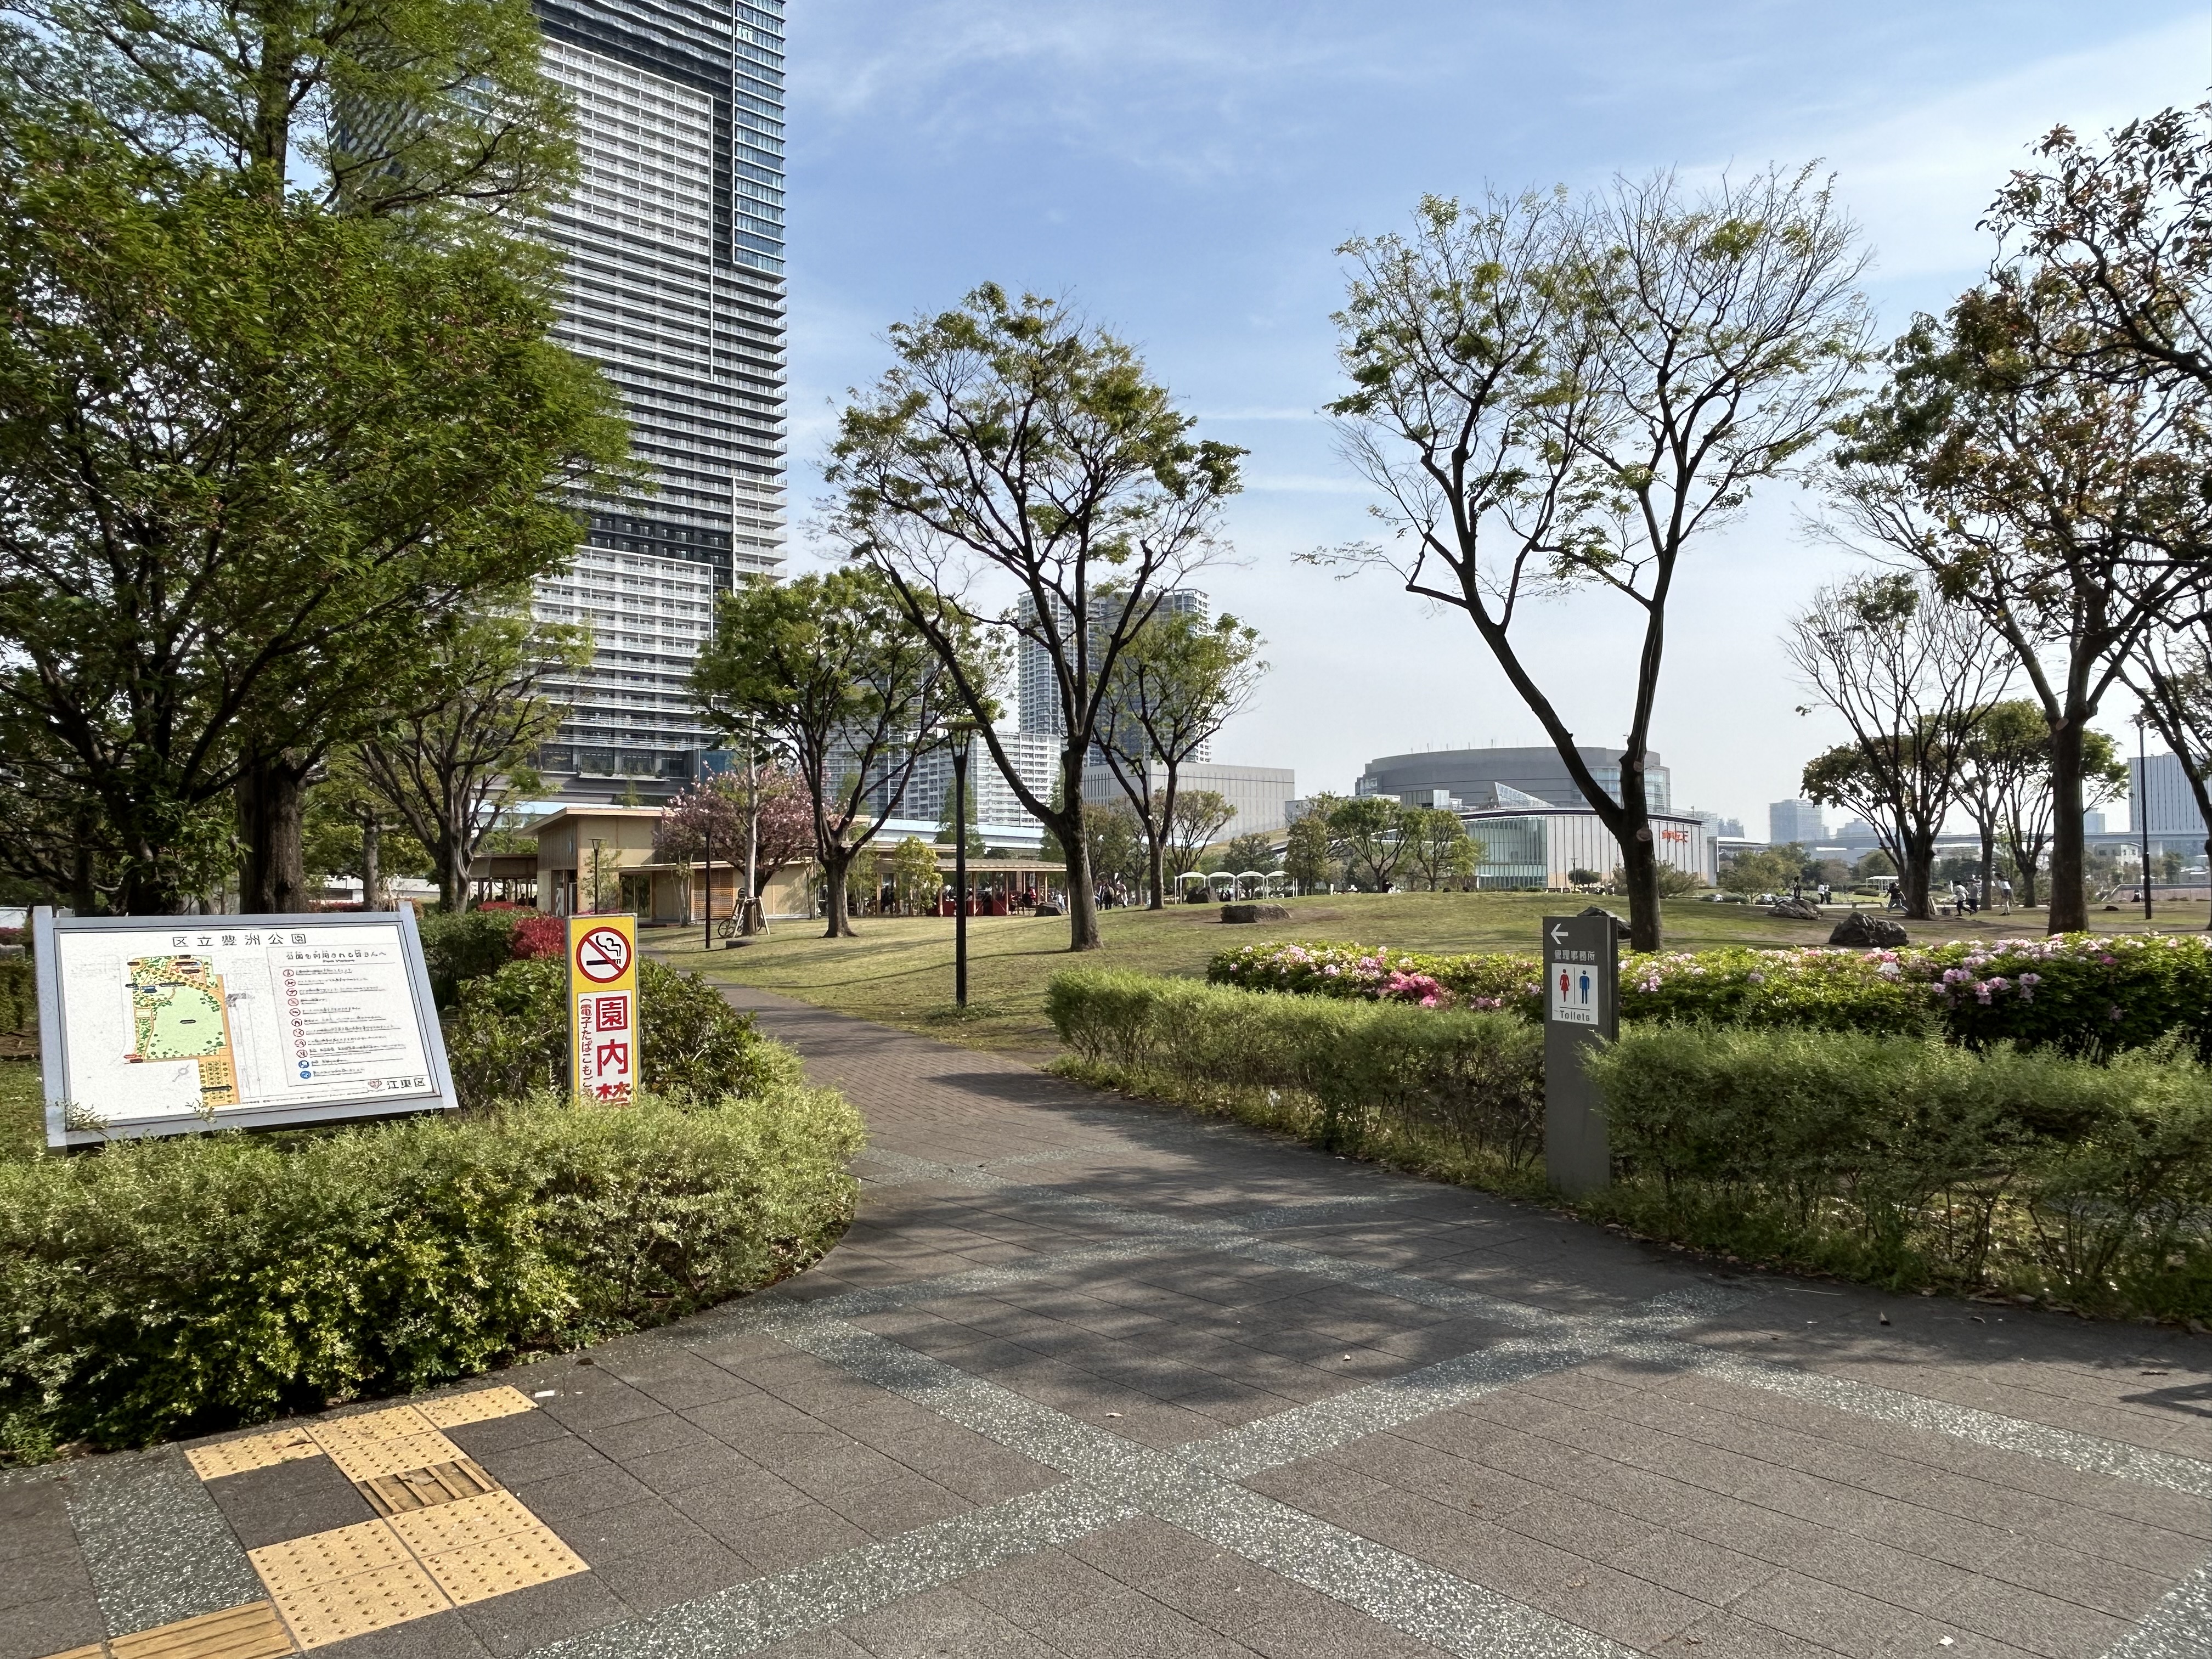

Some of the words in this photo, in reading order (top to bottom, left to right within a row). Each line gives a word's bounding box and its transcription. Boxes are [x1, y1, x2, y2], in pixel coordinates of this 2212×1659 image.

[172, 932, 307, 947] 区立豊洲公園
[1560, 1010, 1590, 1022] Toilets
[387, 1077, 426, 1090] 江東区
